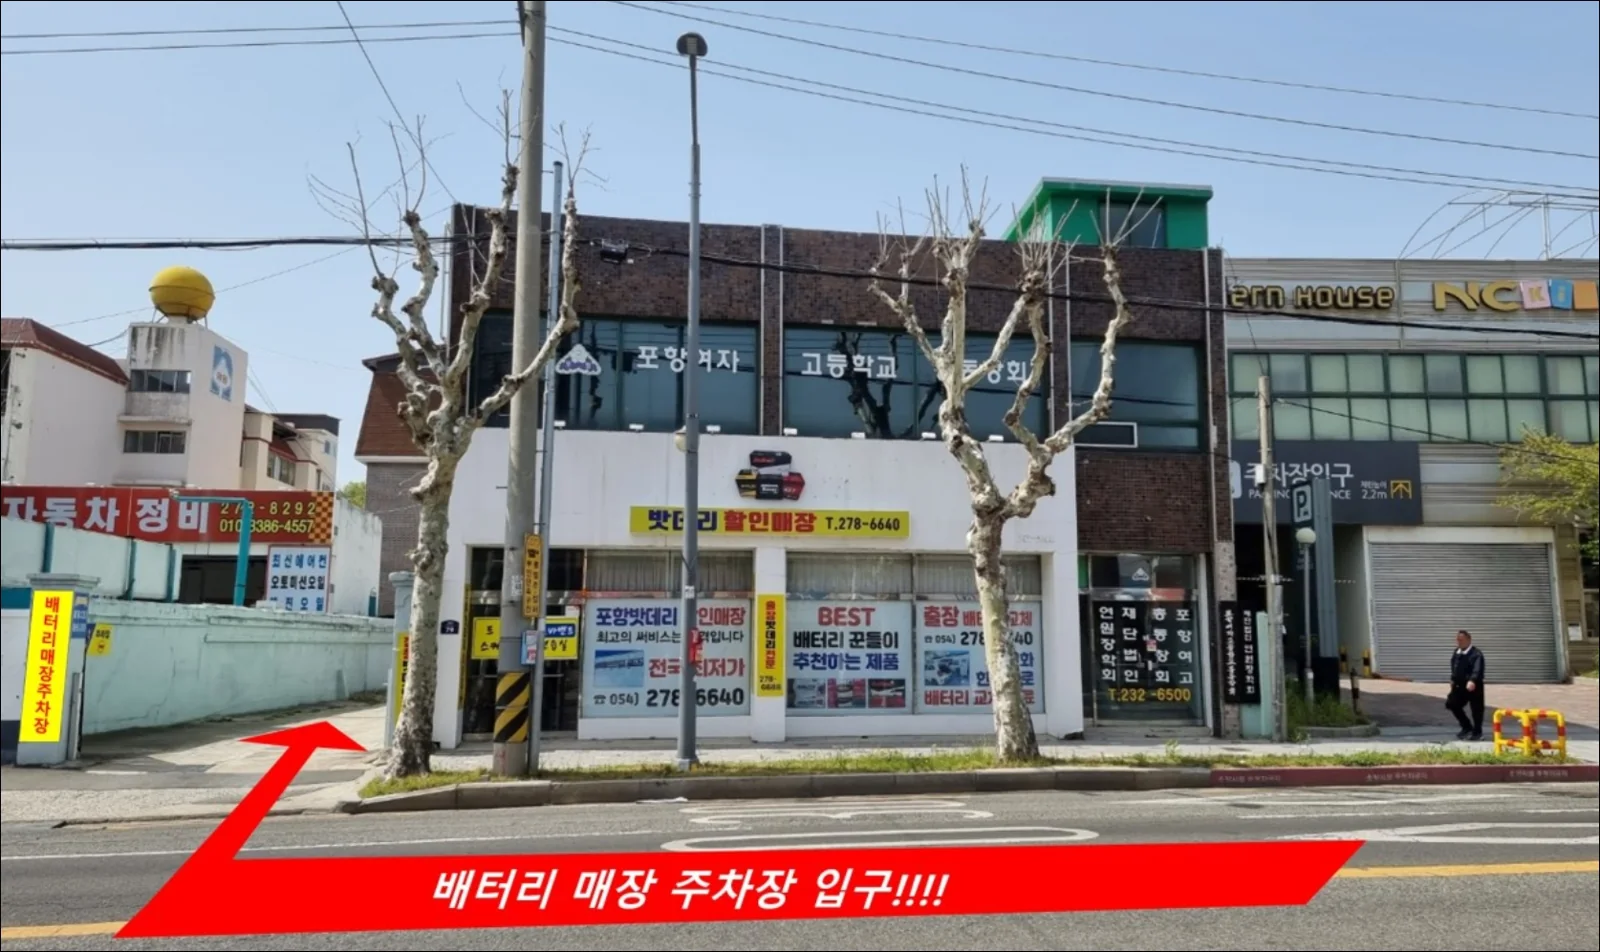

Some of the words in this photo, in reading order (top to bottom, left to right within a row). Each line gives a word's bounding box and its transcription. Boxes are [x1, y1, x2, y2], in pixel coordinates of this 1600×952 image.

[637, 346, 740, 373] 포항여자
[801, 352, 898, 378] 고등학교
[3, 496, 120, 532] 자동차
[136, 498, 209, 533] 정비
[724, 510, 817, 532] 할인매장
[825, 516, 901, 531] T.278-6640
[596, 607, 678, 626] 포항밧데리
[818, 606, 876, 627] BEST
[924, 605, 959, 627] 출장
[596, 630, 632, 643] 최고의
[793, 631, 844, 649] 배터리
[848, 631, 899, 649] 꾼들이
[1099, 606, 1117, 682] 연원장학회
[1122, 607, 1139, 683] 재단법인
[1176, 608, 1193, 684] 포항여고
[793, 652, 861, 670] 추천하는
[865, 652, 899, 670] 제품
[924, 690, 969, 705] 배터리
